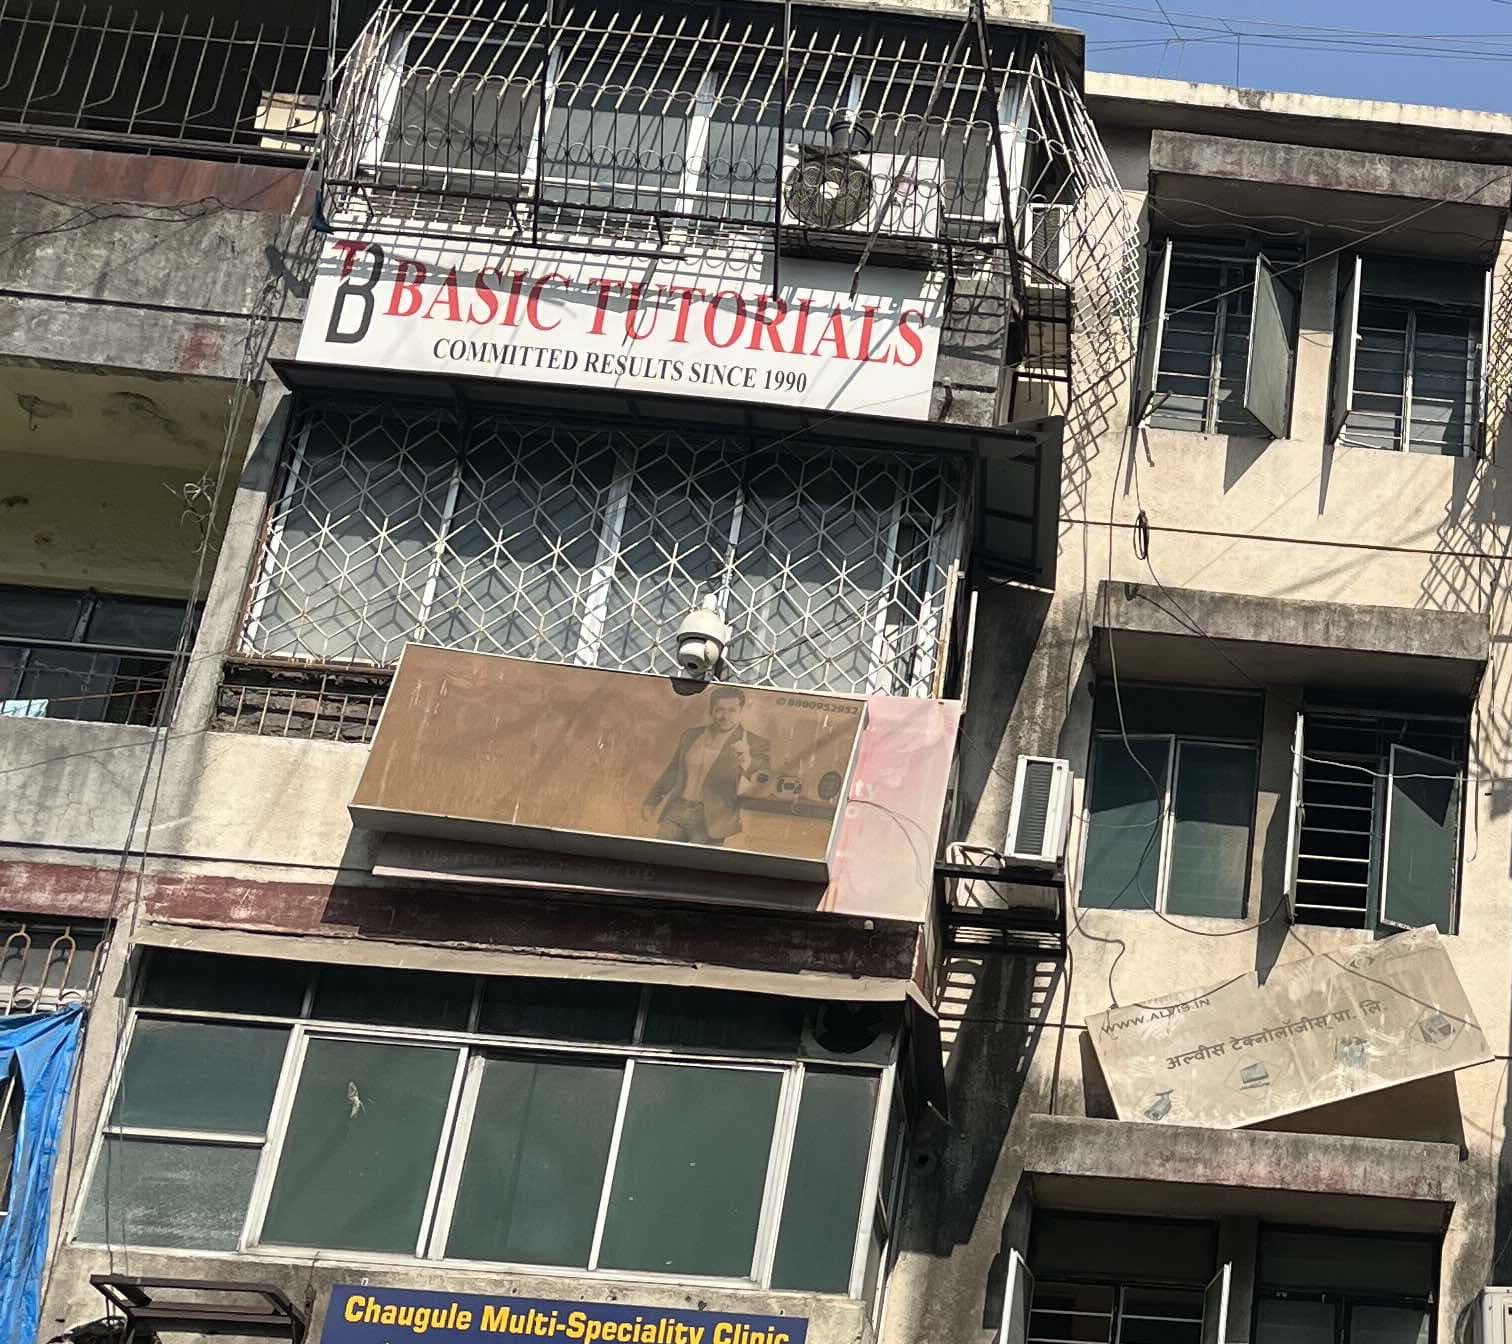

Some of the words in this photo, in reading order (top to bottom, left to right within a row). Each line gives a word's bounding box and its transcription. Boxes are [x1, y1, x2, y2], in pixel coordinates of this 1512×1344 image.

[383, 260, 571, 330] BASIC
[587, 278, 925, 367] TUTORIALS
[434, 339, 578, 370] COMMITTED
[584, 352, 683, 381] RESULTS
[689, 363, 756, 388] SINCE
[765, 370, 806, 392] 1990
[345, 1296, 471, 1333] Chaugule
